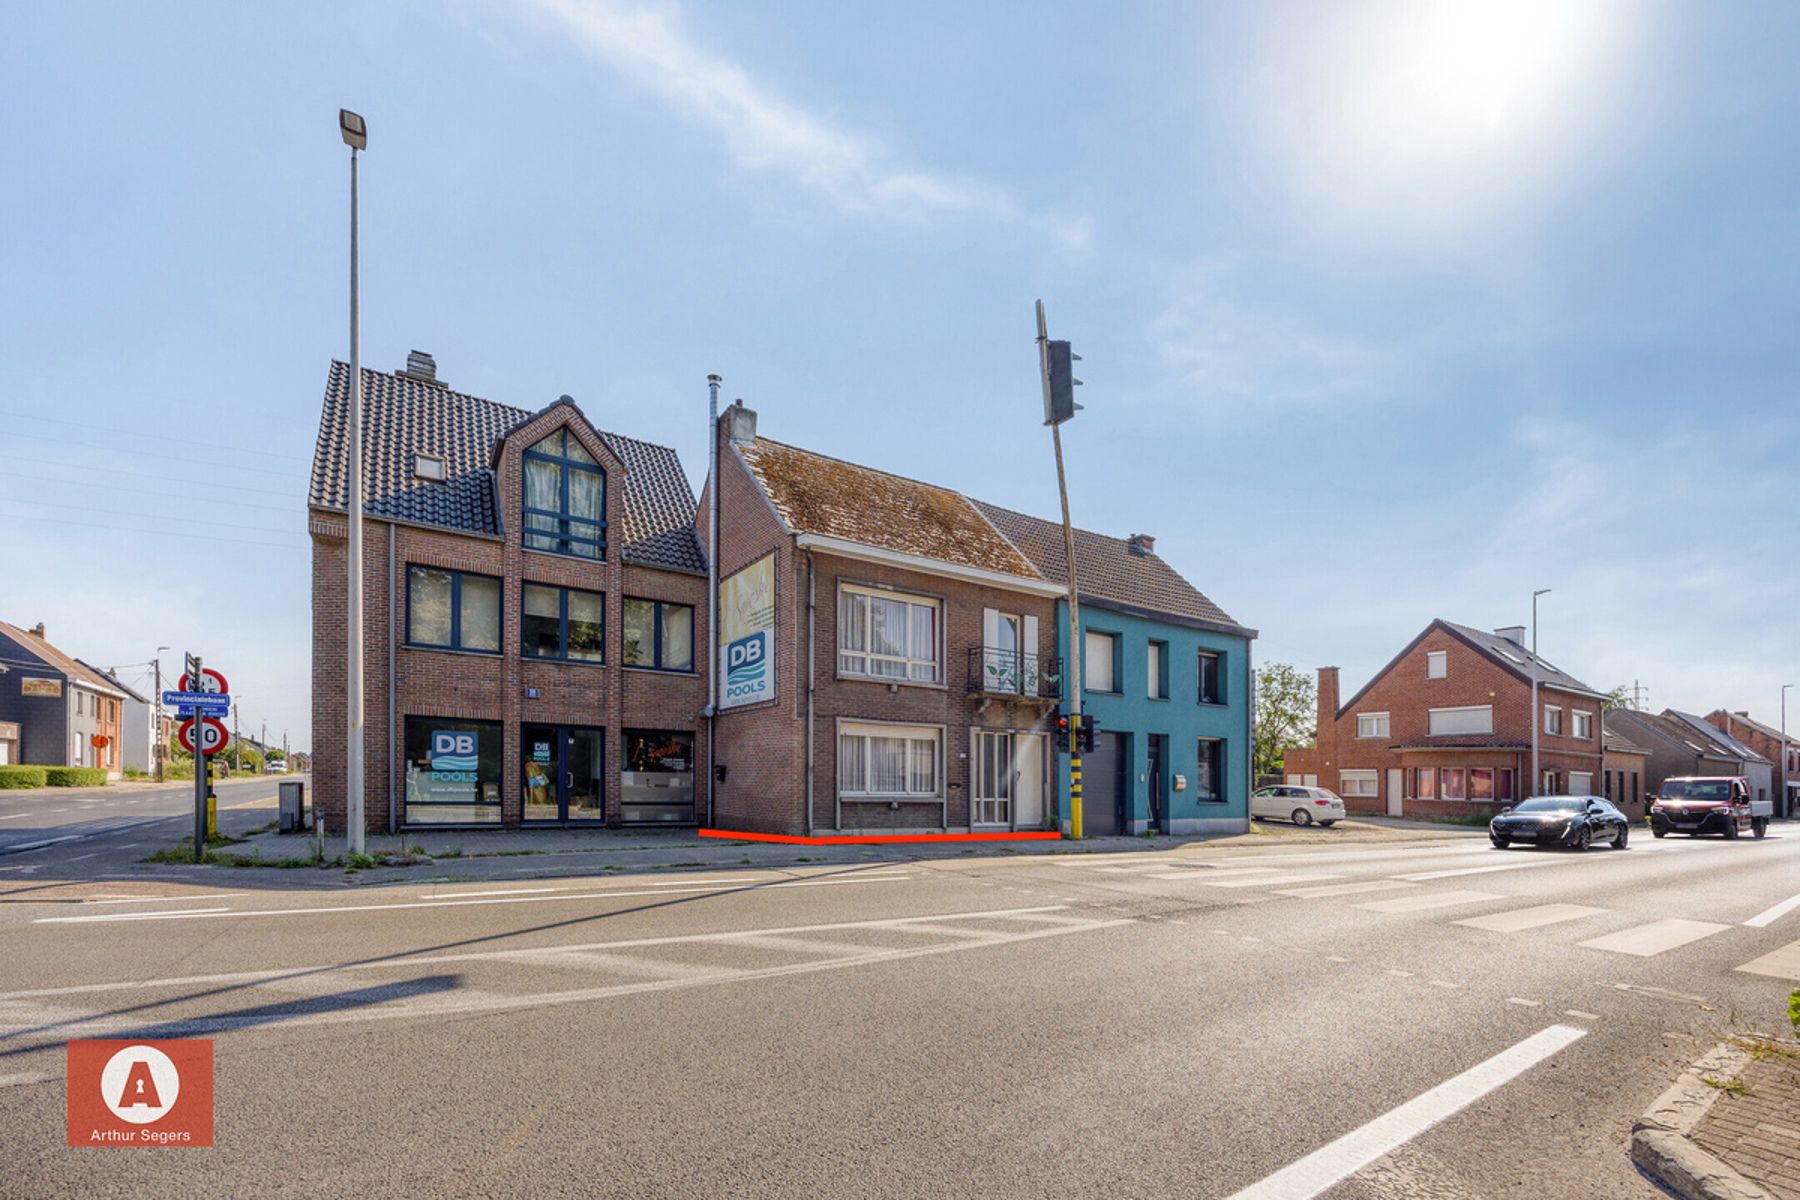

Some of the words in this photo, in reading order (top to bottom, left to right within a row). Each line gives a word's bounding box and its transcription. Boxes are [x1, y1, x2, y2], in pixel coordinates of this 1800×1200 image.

[730, 639, 762, 667] DB
[727, 680, 766, 699] POOLS
[435, 734, 474, 754] DB
[431, 771, 479, 783] POOLS
